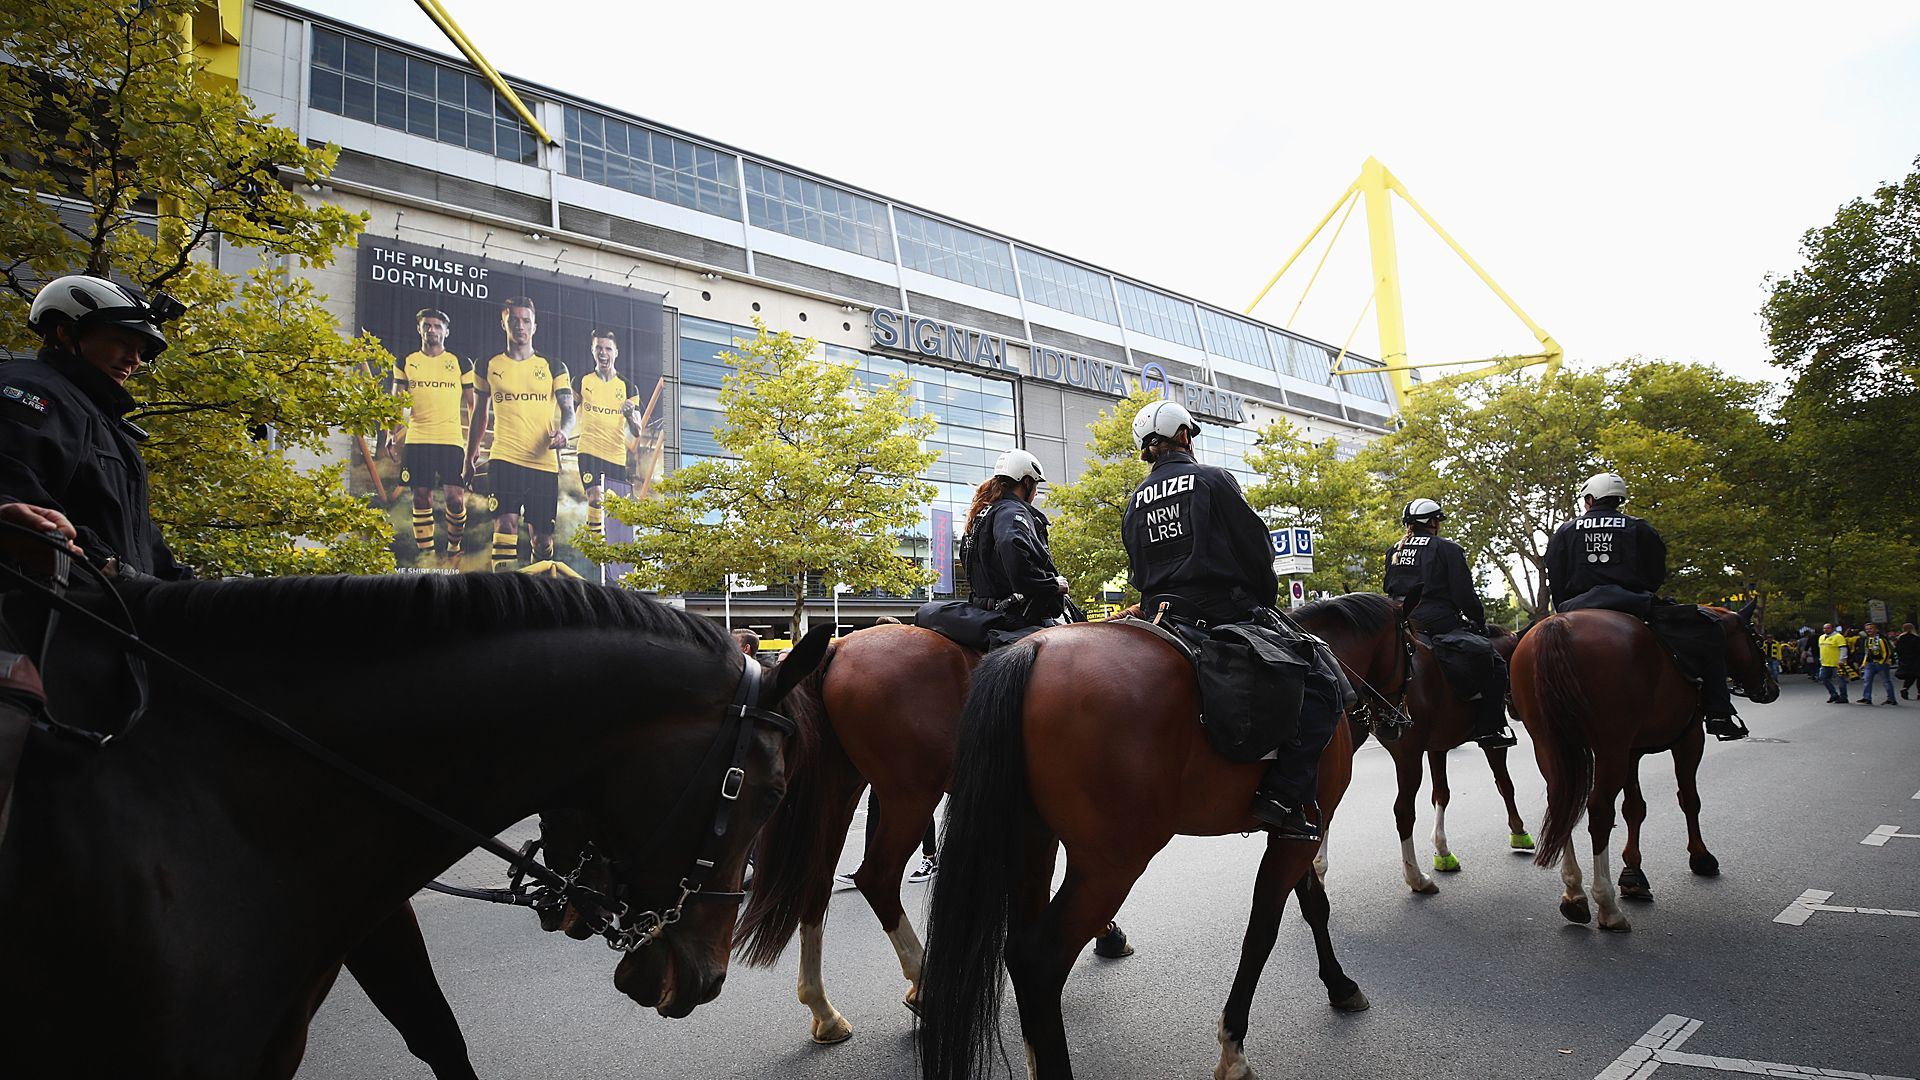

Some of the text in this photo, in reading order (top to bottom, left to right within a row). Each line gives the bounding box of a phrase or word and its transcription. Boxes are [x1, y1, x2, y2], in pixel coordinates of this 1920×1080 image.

[373, 247, 489, 280] THE PULSE OF
[372, 264, 489, 299] DORTMUND
[871, 308, 1248, 423] SIGNAL IDUNA PARK
[416, 381, 456, 389] EVONIK
[504, 392, 548, 401] EVONIK
[1135, 474, 1195, 509] POLIZEI
[1147, 503, 1180, 526] NRW
[1575, 517, 1626, 530] POLIZEI
[1148, 521, 1183, 543] LRSt
[1584, 533, 1613, 542] NRW
[1394, 536, 1430, 550] LIZEI
[1586, 542, 1613, 552] LRSt
[1395, 557, 1415, 566] RSt
